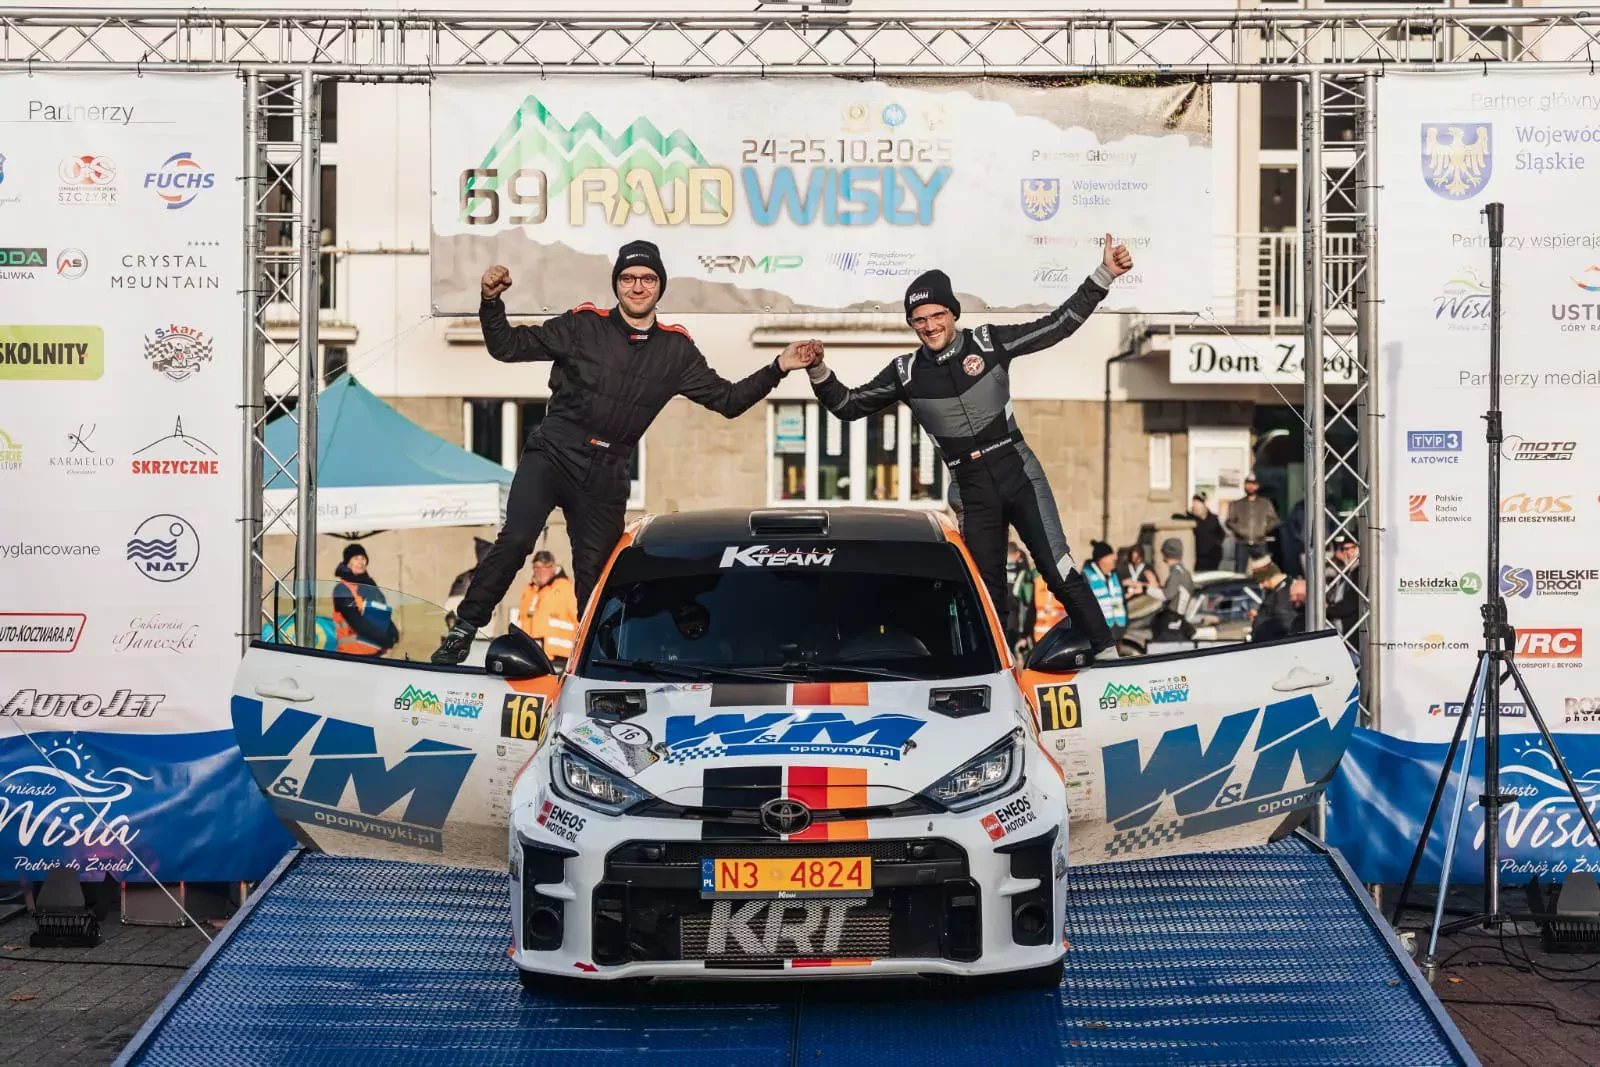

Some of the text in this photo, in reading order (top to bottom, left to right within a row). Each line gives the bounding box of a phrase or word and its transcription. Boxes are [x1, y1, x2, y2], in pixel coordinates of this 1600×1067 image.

[1471, 91, 1600, 112] Partner główny
[29, 100, 134, 125] Partnerzy
[742, 139, 953, 164] 24-25.10.2025
[1514, 150, 1585, 174] Śląskie
[143, 172, 215, 189] FUCHS
[1072, 180, 1148, 193] Województwo
[58, 192, 117, 202] SZCZYRK
[459, 165, 954, 226] 69 RAJD WISŁY
[1071, 193, 1112, 207] Śląskie
[1452, 233, 1526, 250] Partnrzy
[122, 255, 208, 268] CRYSTAL
[714, 255, 803, 273] RMP
[111, 276, 219, 288] MOUNTAIN
[1113, 275, 1142, 284] RON
[1551, 304, 1600, 320] UST
[155, 323, 204, 340] S-kart
[1560, 323, 1586, 332] GÓRY
[1189, 342, 1260, 373] Dom
[1459, 370, 1540, 389] Parerzy
[1518, 442, 1577, 451] MOTO
[49, 457, 114, 466] KARMELLO
[1410, 456, 1459, 464] KATOWICE
[1514, 452, 1574, 461] WIZJA
[132, 460, 218, 475] SKRZYCZNE
[1435, 494, 1463, 502] Polskie
[1435, 504, 1458, 512] Radio
[1435, 514, 1472, 522] Katowice
[0, 541, 100, 559] yglancowane
[146, 562, 189, 572] NAT
[1535, 570, 1599, 580] BIELSKIE
[1400, 577, 1477, 590] beskidzka 24
[1535, 580, 1582, 590] DROGI
[129, 613, 184, 630] Cukiernia
[121, 623, 199, 655] Janeczki
[1387, 641, 1470, 651] motorsport.com
[1042, 686, 1078, 729] 16
[1099, 696, 1117, 709] 69
[1151, 689, 1189, 705] WISŁY
[394, 697, 411, 711] 69
[444, 702, 483, 719] WISŁY
[507, 695, 537, 738] 16
[619, 728, 640, 740] 16
[790, 744, 895, 757] oponymyki.pl
[5, 783, 57, 795] miasto
[995, 795, 1031, 823] ENEOS
[314, 808, 435, 845] oponymyki.pl
[550, 804, 587, 832] ENEOS
[1004, 811, 1037, 834] MOTOR OIL
[546, 820, 579, 844] MOTOR OIL
[85, 854, 134, 872] Źródeł
[1501, 855, 1600, 876] Podróż do Źró
[721, 859, 863, 889] N3 4824
[703, 879, 714, 887] PL
[706, 899, 867, 954] KRT
